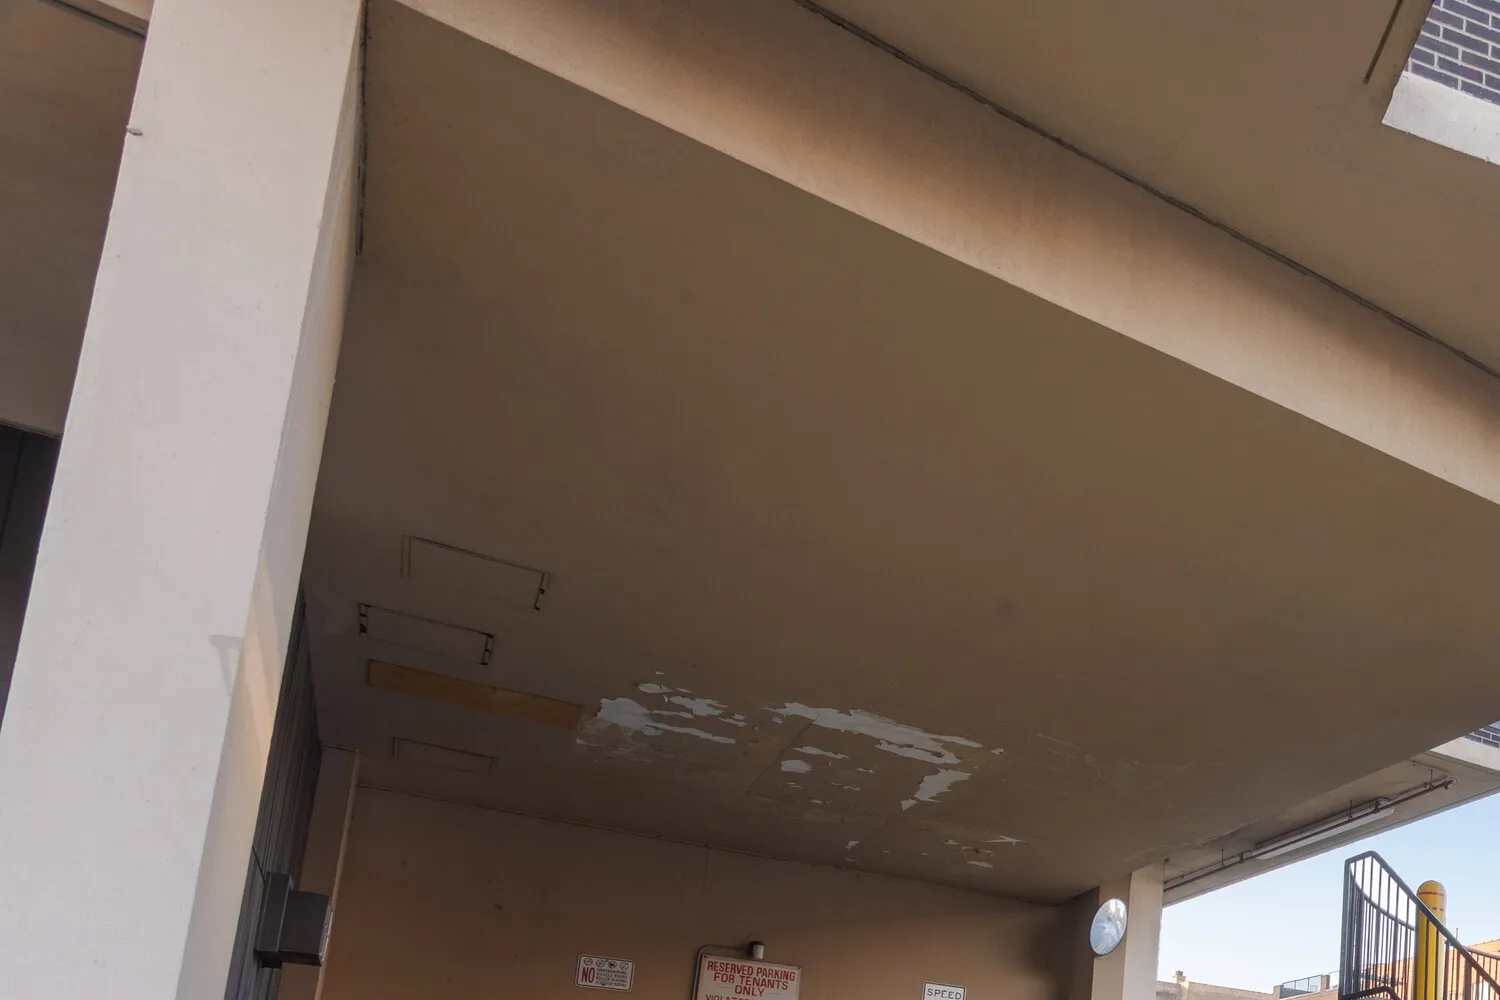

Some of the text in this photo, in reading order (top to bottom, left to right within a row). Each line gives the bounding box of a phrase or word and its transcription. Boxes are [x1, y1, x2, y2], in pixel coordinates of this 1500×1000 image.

[581, 967, 595, 983] NO
[707, 960, 795, 981] RESERVED PARKING
[713, 972, 789, 990] FOR TENANTS
[734, 984, 766, 997] ONLY
[927, 988, 962, 1000] SPEED
